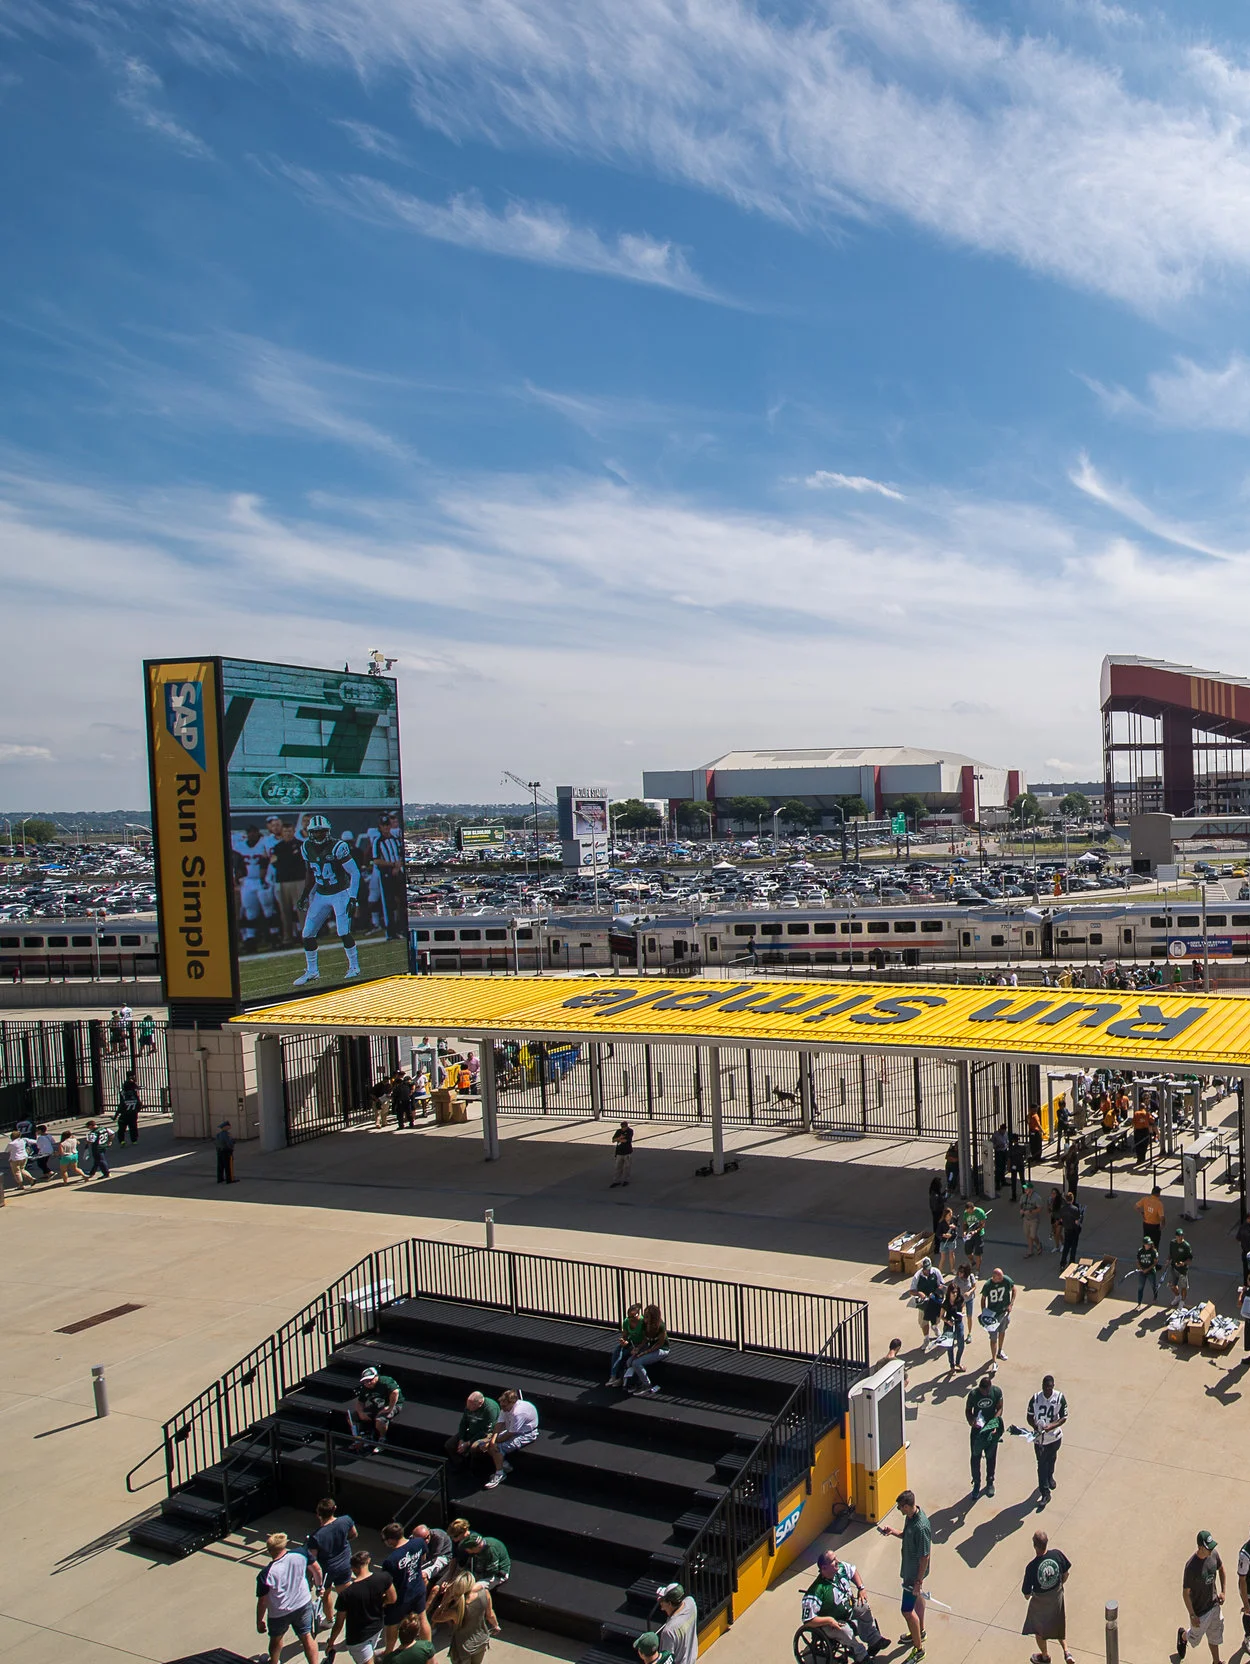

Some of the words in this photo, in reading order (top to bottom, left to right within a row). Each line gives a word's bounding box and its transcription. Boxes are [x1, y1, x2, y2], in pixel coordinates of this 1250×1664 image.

[171, 683, 199, 750] SAP
[176, 773, 201, 843] Run
[267, 785, 301, 797] JETS
[310, 862, 338, 886] 24
[176, 856, 211, 980] Simple
[562, 985, 948, 1025] Simple
[968, 998, 1209, 1041] Run
[990, 1286, 1006, 1303] 87
[1038, 1405, 1055, 1423] 24
[776, 1511, 800, 1544] SAP
